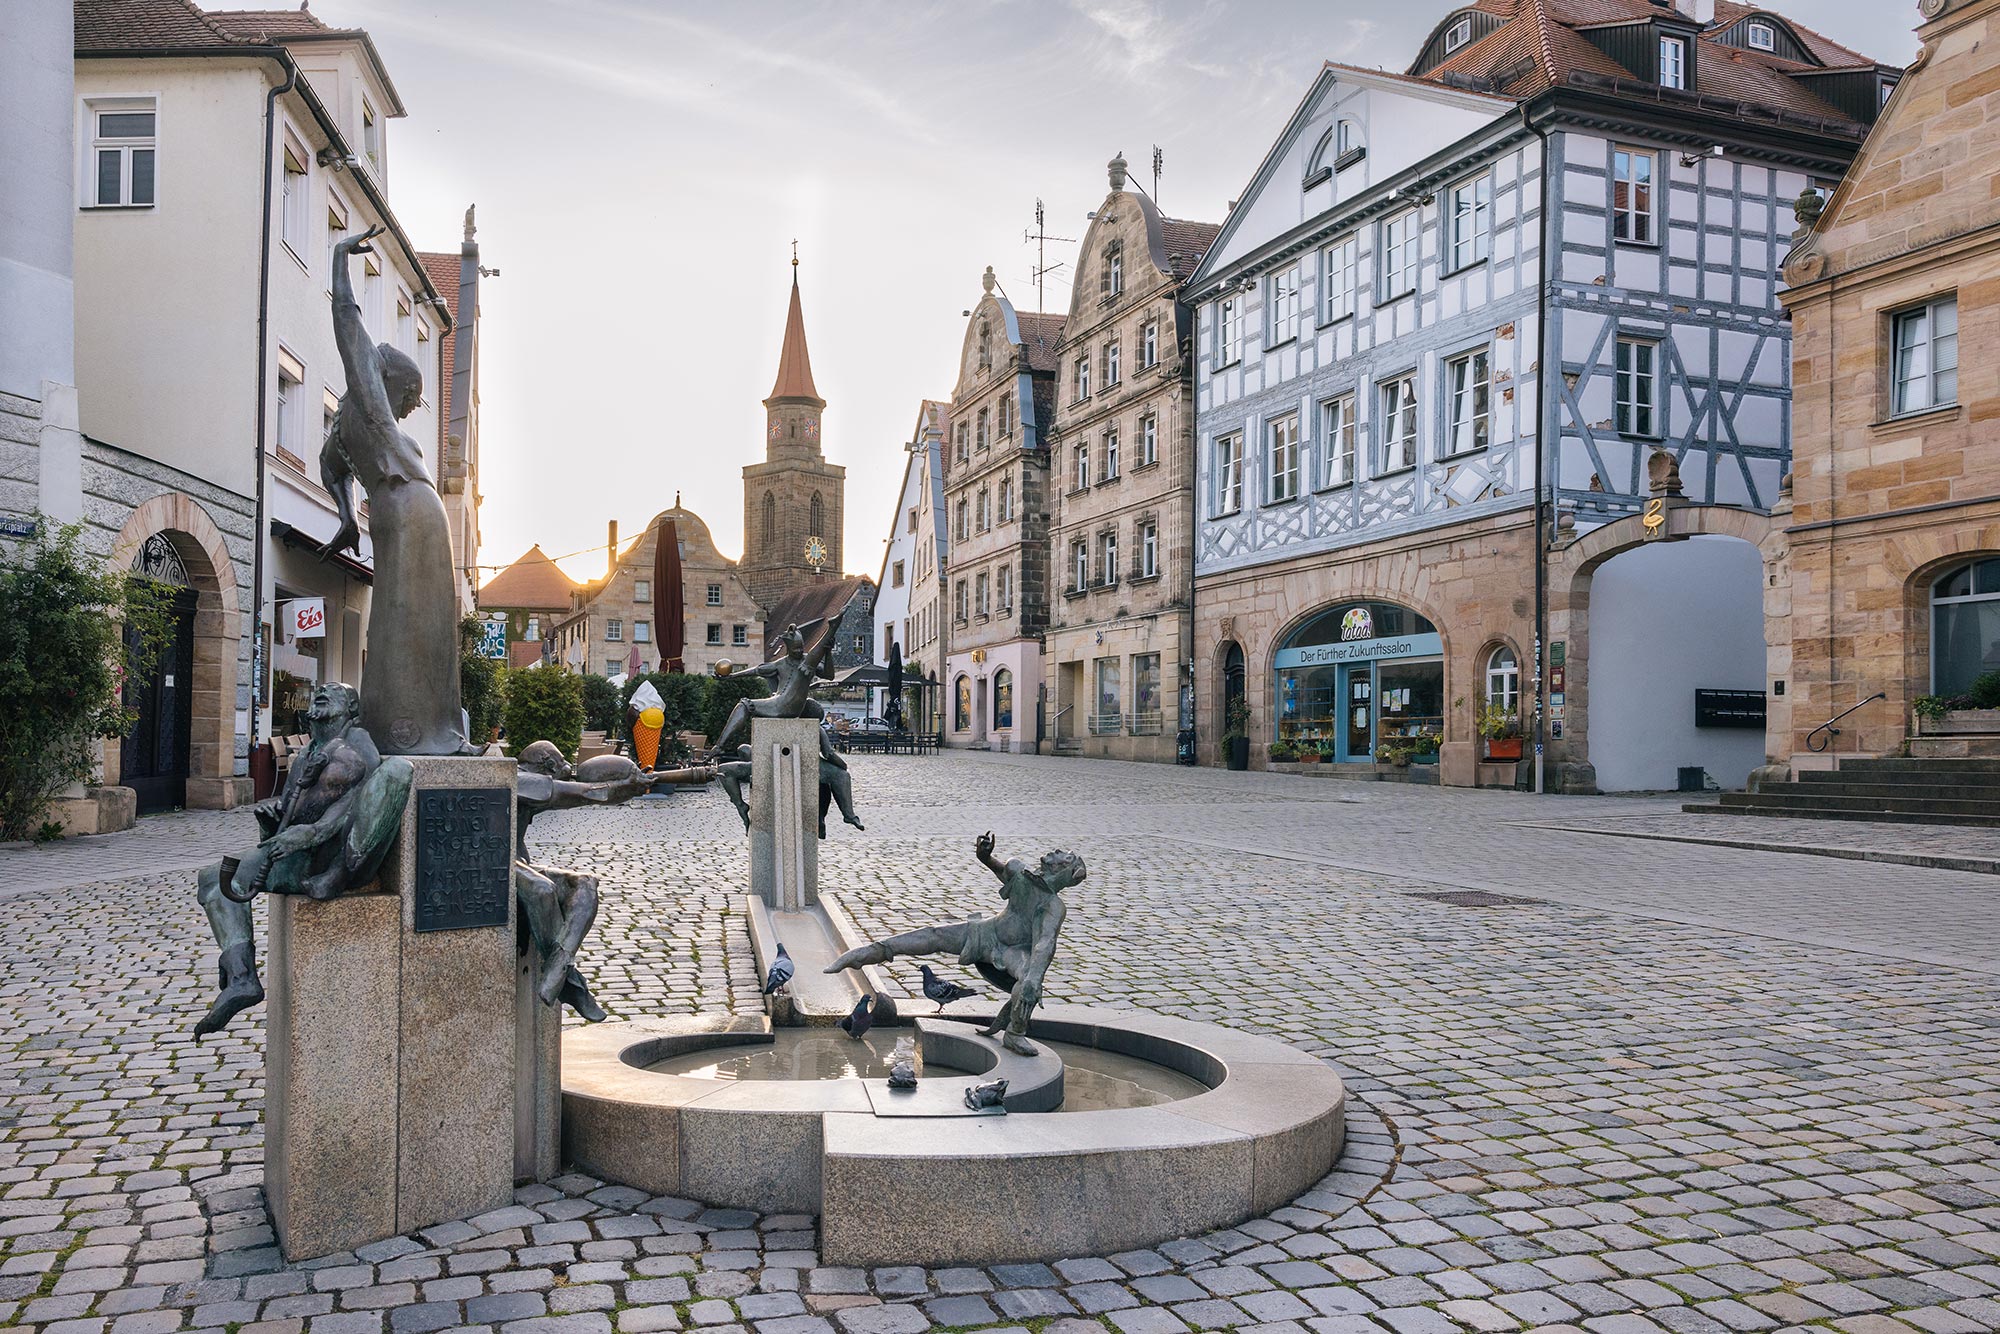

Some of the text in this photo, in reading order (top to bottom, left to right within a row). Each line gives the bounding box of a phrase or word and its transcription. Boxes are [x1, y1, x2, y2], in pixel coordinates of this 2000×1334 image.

[297, 606, 323, 632] Eis
[286, 633, 295, 644] 7
[1301, 641, 1412, 662] Der Fürther Zukunftssalon
